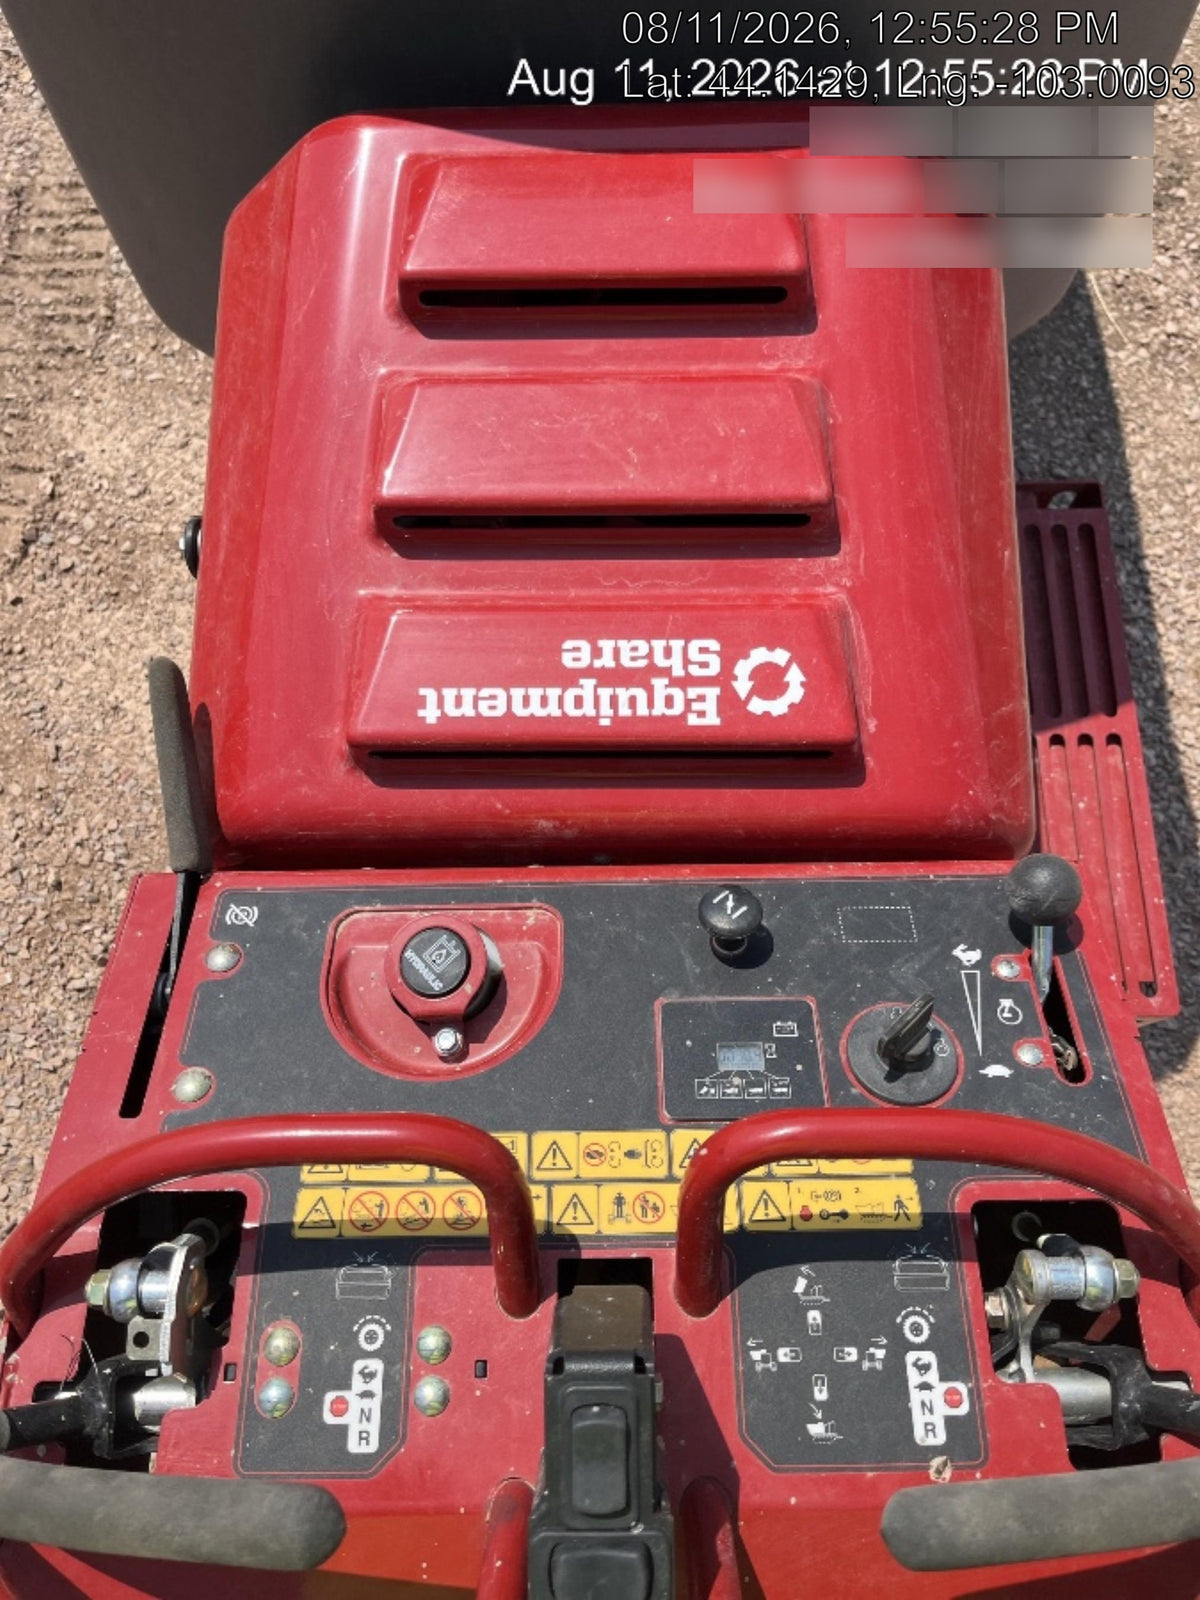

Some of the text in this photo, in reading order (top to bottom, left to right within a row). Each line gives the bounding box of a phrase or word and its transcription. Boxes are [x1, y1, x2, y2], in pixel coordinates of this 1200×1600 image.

[561, 639, 721, 677] Share
[417, 678, 721, 726] Equipment
[359, 1407, 372, 1424] N
[921, 1399, 934, 1416] N
[358, 1430, 371, 1447] R
[924, 1422, 937, 1439] R
